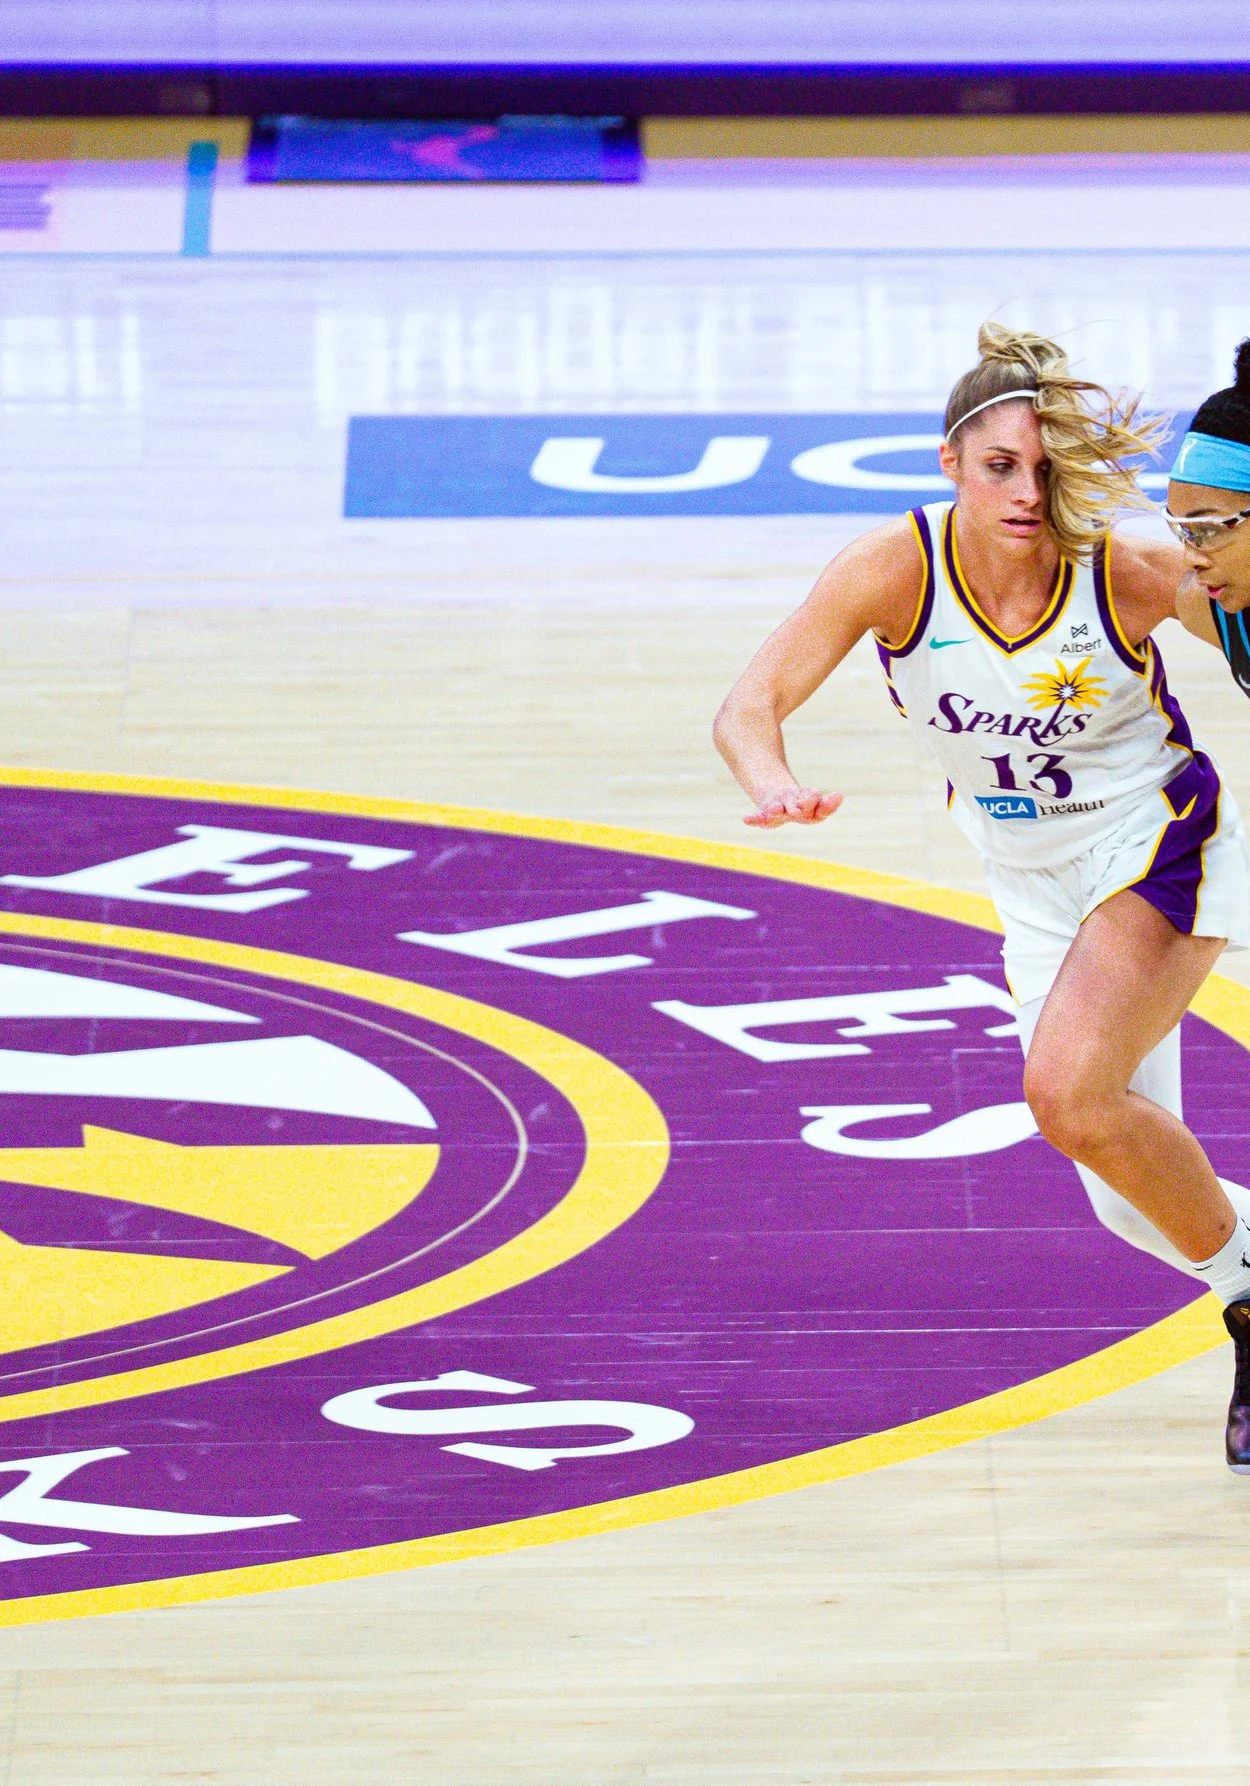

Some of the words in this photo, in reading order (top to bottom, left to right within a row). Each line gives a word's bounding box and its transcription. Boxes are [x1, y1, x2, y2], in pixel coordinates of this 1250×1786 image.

[1060, 638, 1102, 654] Albert
[981, 752, 1073, 799] 13
[982, 800, 1029, 815] UCLA
